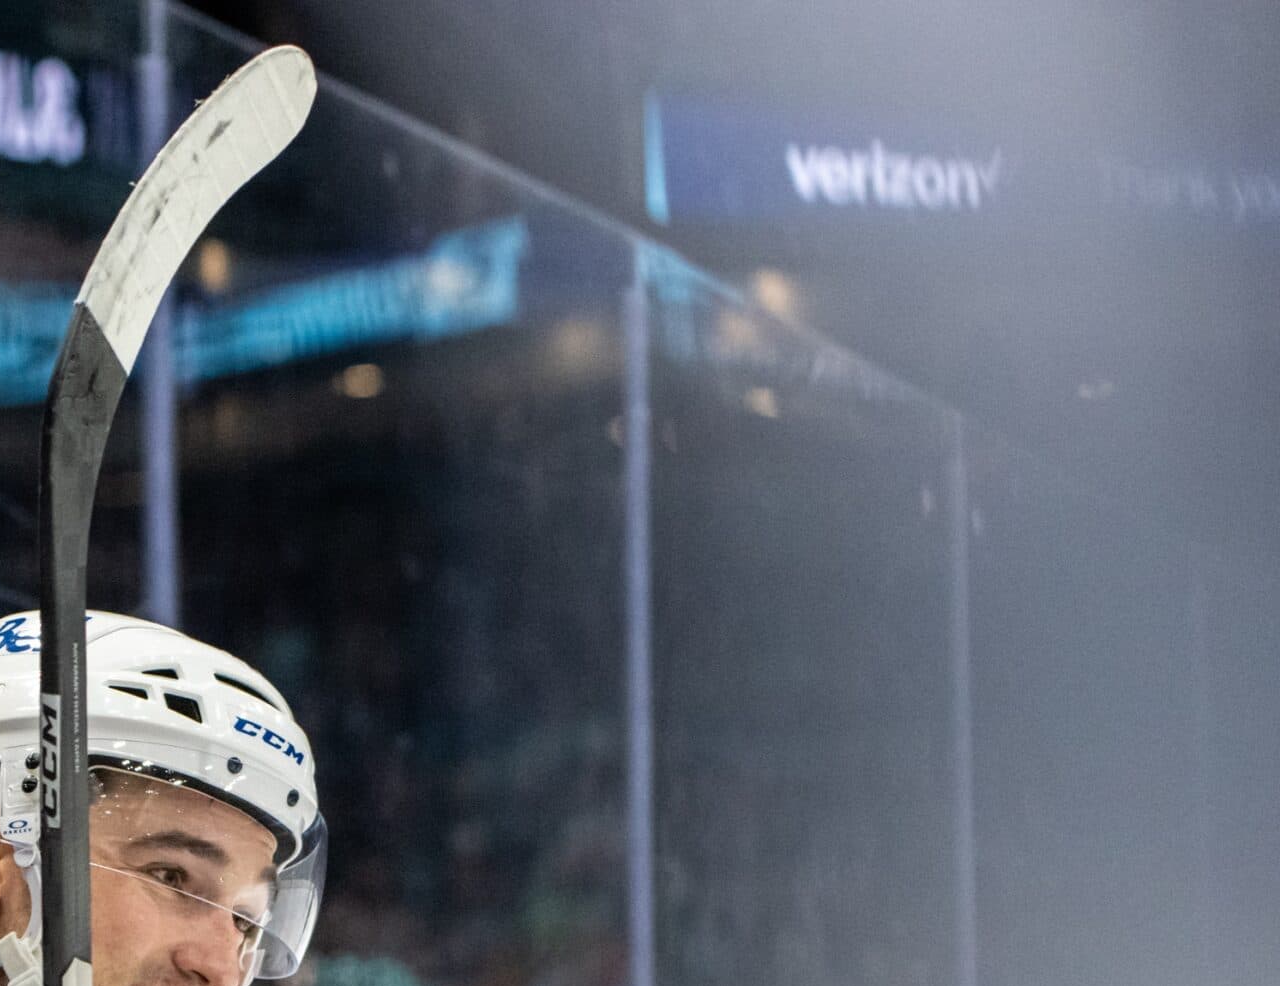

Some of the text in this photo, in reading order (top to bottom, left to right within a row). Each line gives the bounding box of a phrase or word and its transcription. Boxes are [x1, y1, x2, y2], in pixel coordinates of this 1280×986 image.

[785, 138, 983, 210] verizon
[41, 703, 57, 818] CCM
[233, 715, 304, 766] CCM
